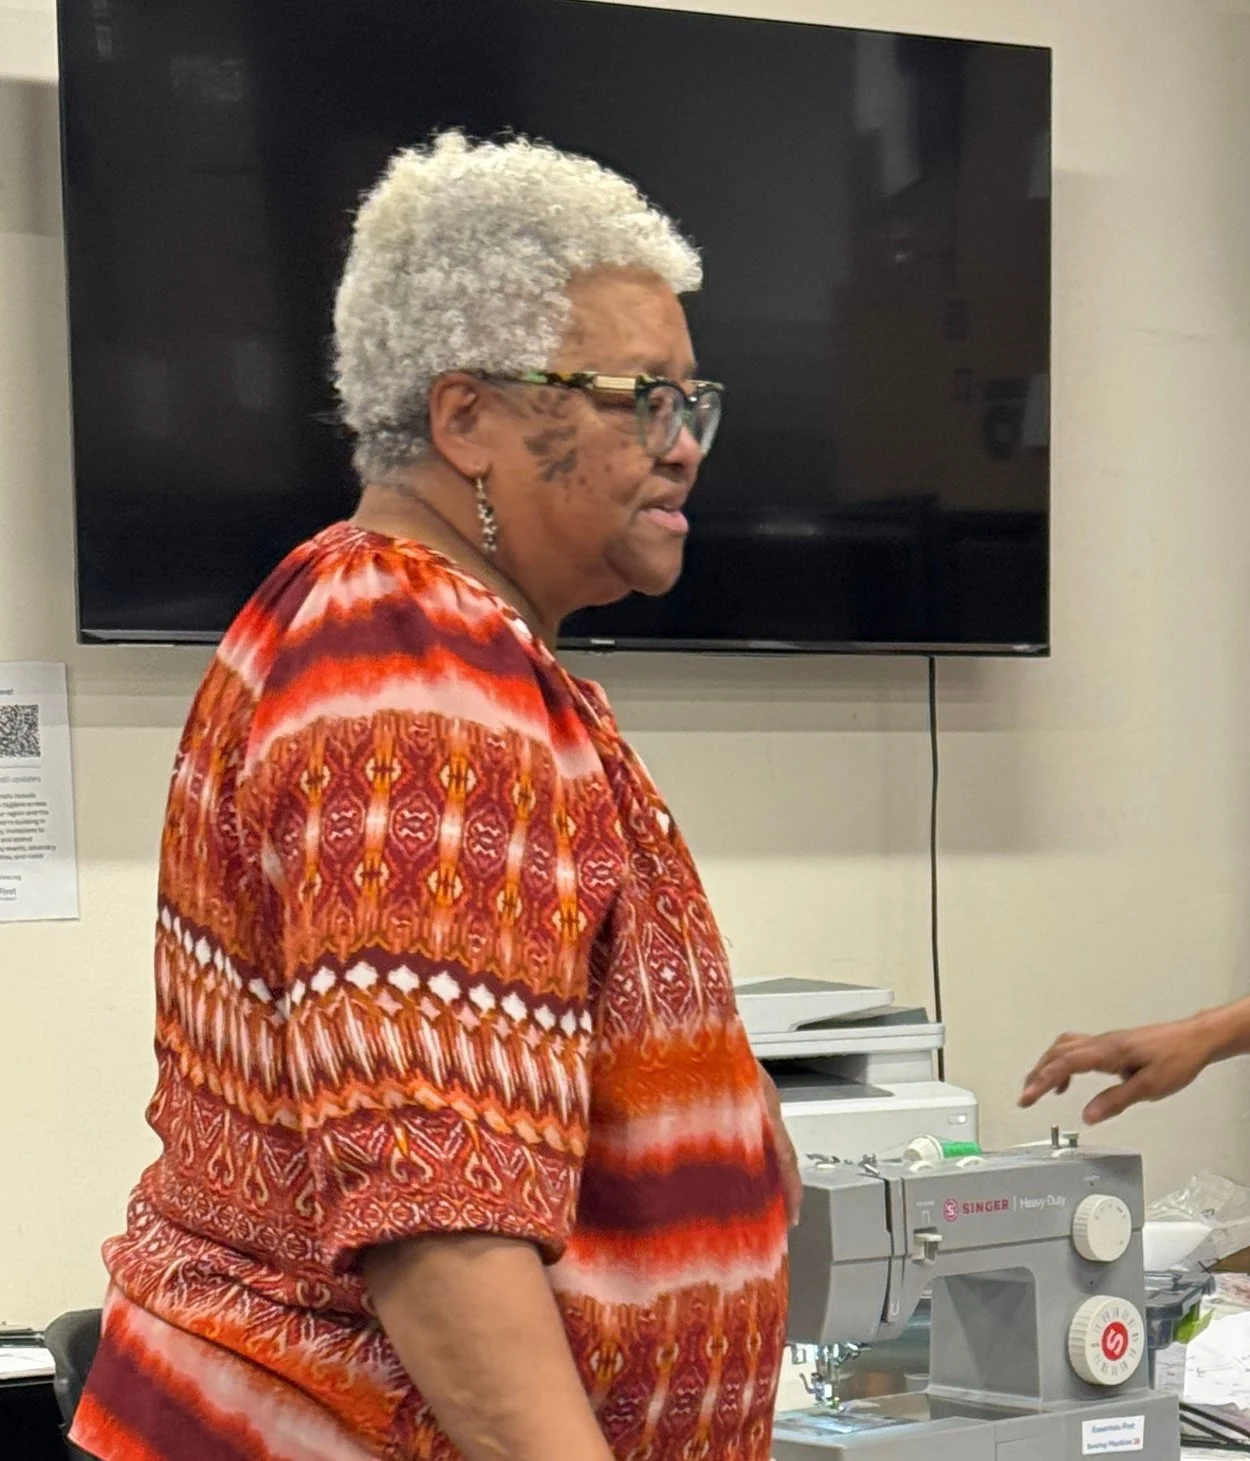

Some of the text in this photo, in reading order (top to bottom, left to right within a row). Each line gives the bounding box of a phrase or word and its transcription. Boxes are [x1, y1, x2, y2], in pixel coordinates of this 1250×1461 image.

[962, 1199, 1009, 1215] SINGER
[1020, 1197, 1045, 1210] Heavy
[1047, 1194, 1066, 1208] Duty
